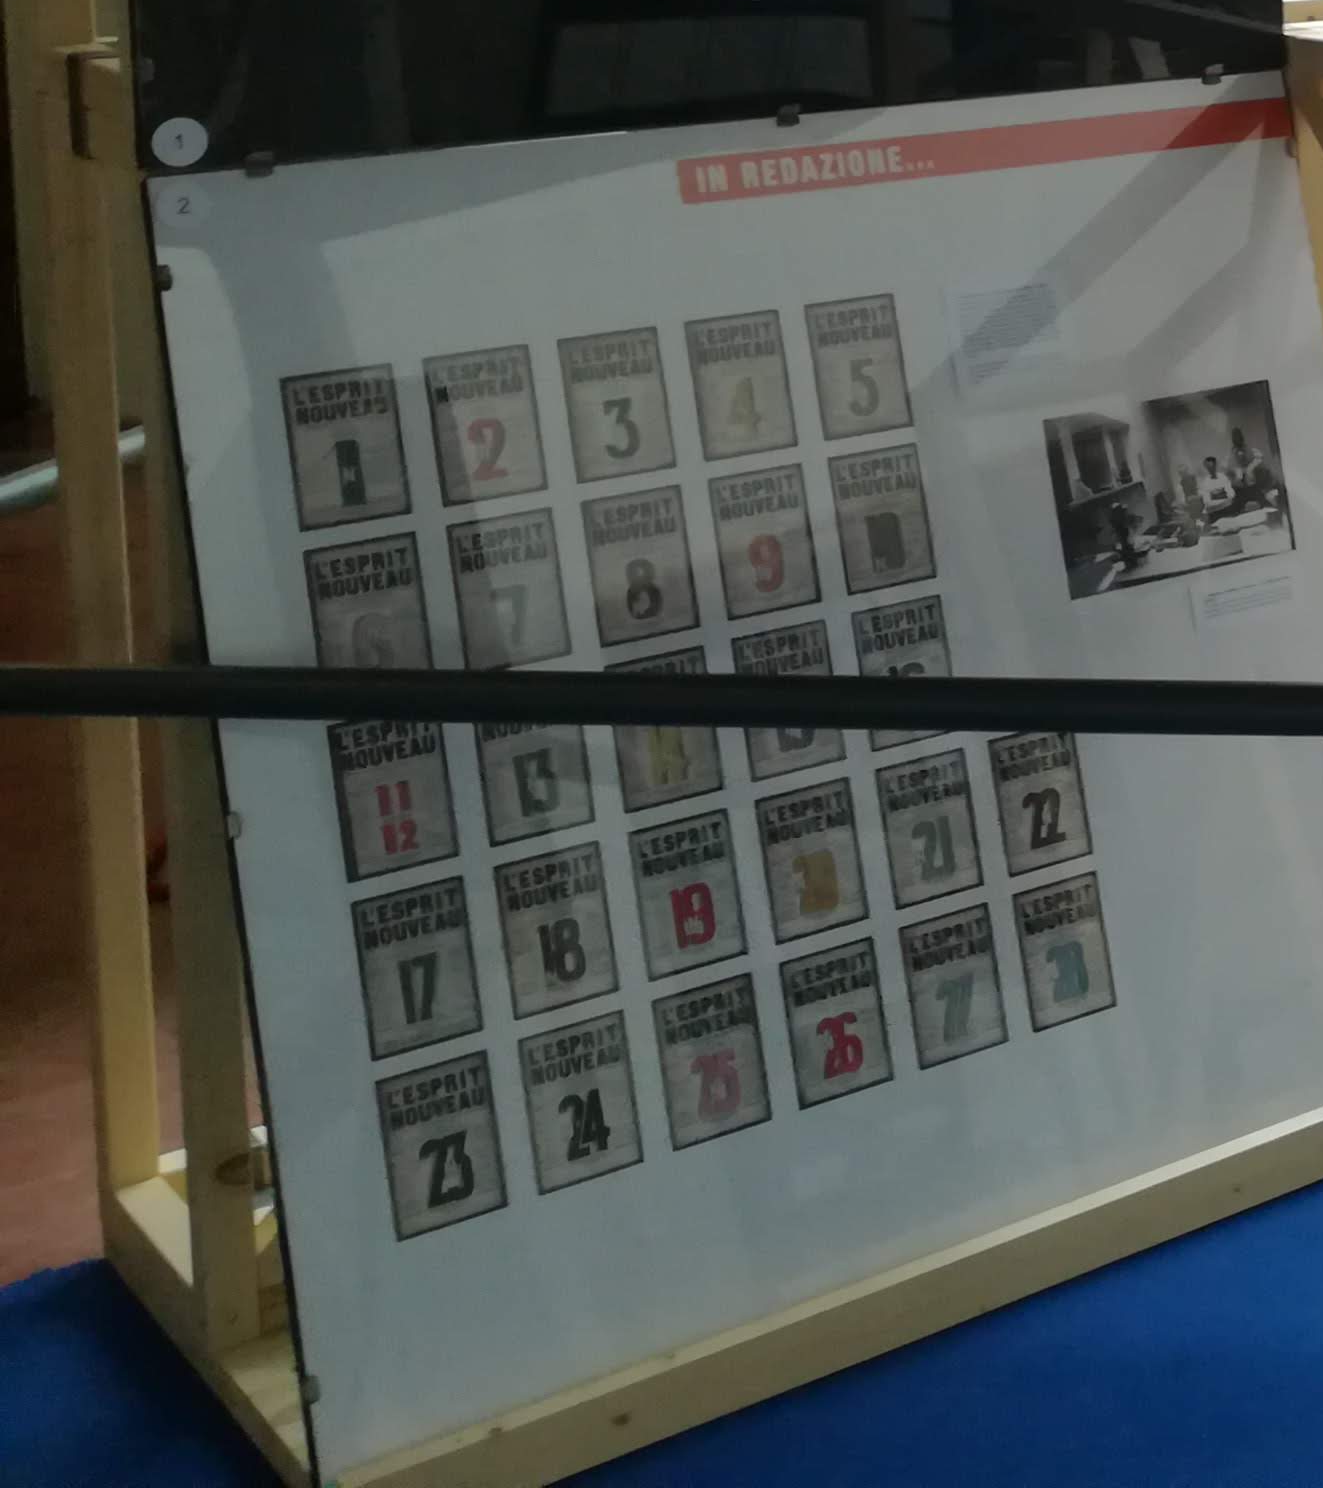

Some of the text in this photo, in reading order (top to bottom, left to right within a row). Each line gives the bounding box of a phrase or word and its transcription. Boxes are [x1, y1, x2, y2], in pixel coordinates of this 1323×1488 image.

[174, 132, 184, 151] 1
[695, 163, 729, 193] IN
[176, 196, 190, 215] 2
[694, 321, 772, 346] L'ESPRIT
[815, 304, 888, 329] L'ESPRIT
[817, 322, 893, 346] NOUVEAU
[568, 338, 649, 363] L'ESPRIT
[699, 340, 776, 364] NOUVEAU
[432, 358, 522, 385] L'ESPRIT
[434, 376, 523, 403] NOUVEAU
[571, 359, 652, 384] NOUVEAU
[849, 359, 879, 416] 5
[291, 378, 384, 405] L'ESPRIT
[730, 377, 762, 431] 4
[295, 397, 388, 425] NOUVEAU
[603, 398, 640, 459] 3
[467, 418, 510, 480] 2
[322, 439, 367, 506] 1
[836, 453, 912, 482] L'ESPRIT
[838, 471, 916, 499] NOUVEAU
[715, 472, 794, 503] L'ESPRIT
[591, 498, 672, 527] L'ESPRIT
[719, 492, 799, 521] NOUVEAU
[456, 522, 544, 553] L'ESPRIT
[593, 518, 676, 546] NOUVEAU
[316, 547, 408, 580] L'ESPRIT
[460, 541, 546, 574] NOUVEAU
[750, 534, 784, 593] 9
[318, 567, 413, 601] NOUVEAU
[625, 559, 663, 620] 8
[490, 583, 527, 646] 7
[859, 605, 936, 634] L'ESPRIT
[738, 630, 818, 659] L'ESPRIT
[862, 623, 940, 656] NOUVEAU
[345, 734, 435, 771] NOUVEAU
[1000, 752, 1072, 781] NOUVEAU
[512, 748, 560, 816] 13
[885, 762, 959, 795] L'ESPRIT
[374, 780, 412, 817] 11
[767, 791, 842, 825] L'ESPRIT
[887, 782, 967, 812] NOUVEAU
[767, 809, 849, 844] NOUVEAU
[1022, 787, 1066, 850] 22
[382, 819, 419, 856] 12
[639, 821, 721, 858] L'ESPRIT
[912, 816, 956, 882] 21
[503, 854, 593, 893] L'ESPRIT
[642, 842, 725, 878] NOUVEAU
[360, 887, 457, 927] L'ESPRIT
[506, 876, 598, 912] NOUVEAU
[1020, 883, 1093, 919] L'ESPRIT
[363, 908, 462, 950] NOUVEAU
[669, 882, 717, 950] 19
[1023, 904, 1097, 936] NOUVEAU
[537, 917, 586, 983] 18
[908, 917, 987, 955] L'ESPRIT
[789, 952, 869, 990] L'ESPRIT
[910, 939, 990, 972] NOUVEAU
[398, 952, 438, 1024] 17
[663, 987, 748, 1025] L'ESPRIT
[794, 971, 872, 1008] NOUVEAU
[527, 1023, 617, 1063] L'ESPRIT
[666, 1011, 753, 1044] NOUVEAU
[816, 1012, 865, 1080] 26
[530, 1048, 620, 1086] NOUVEAU
[690, 1048, 742, 1120] 25
[386, 1066, 480, 1108] L'ESPRIT
[389, 1088, 486, 1130] NOUVEAU
[558, 1088, 611, 1163] 24
[418, 1130, 475, 1209] 23
